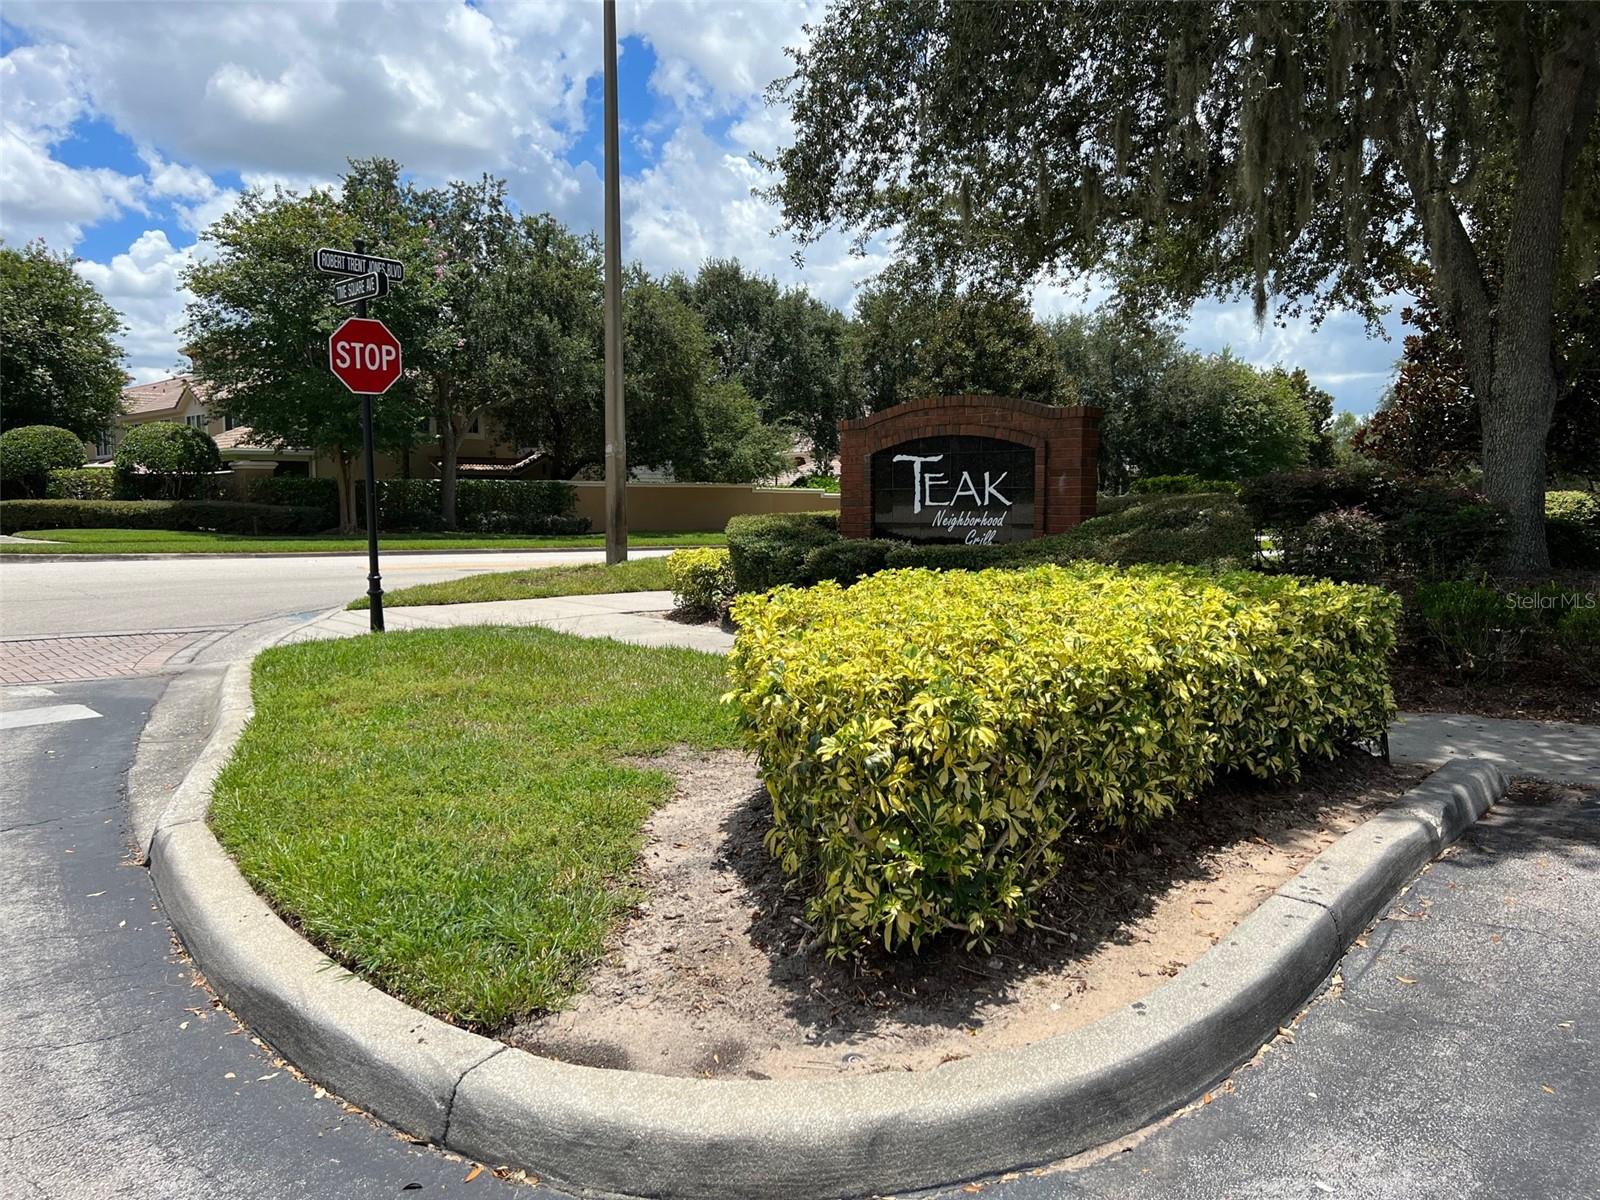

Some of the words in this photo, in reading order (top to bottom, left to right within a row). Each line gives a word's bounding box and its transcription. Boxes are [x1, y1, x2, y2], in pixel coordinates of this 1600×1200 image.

[321, 252, 345, 270] ROBERT
[346, 256, 366, 273] TRENT
[386, 263, 402, 279] BLVD
[336, 341, 396, 371] STOP
[892, 454, 1013, 514] TEAK
[932, 509, 1007, 532] Neighborhood
[965, 529, 997, 545] Grill
